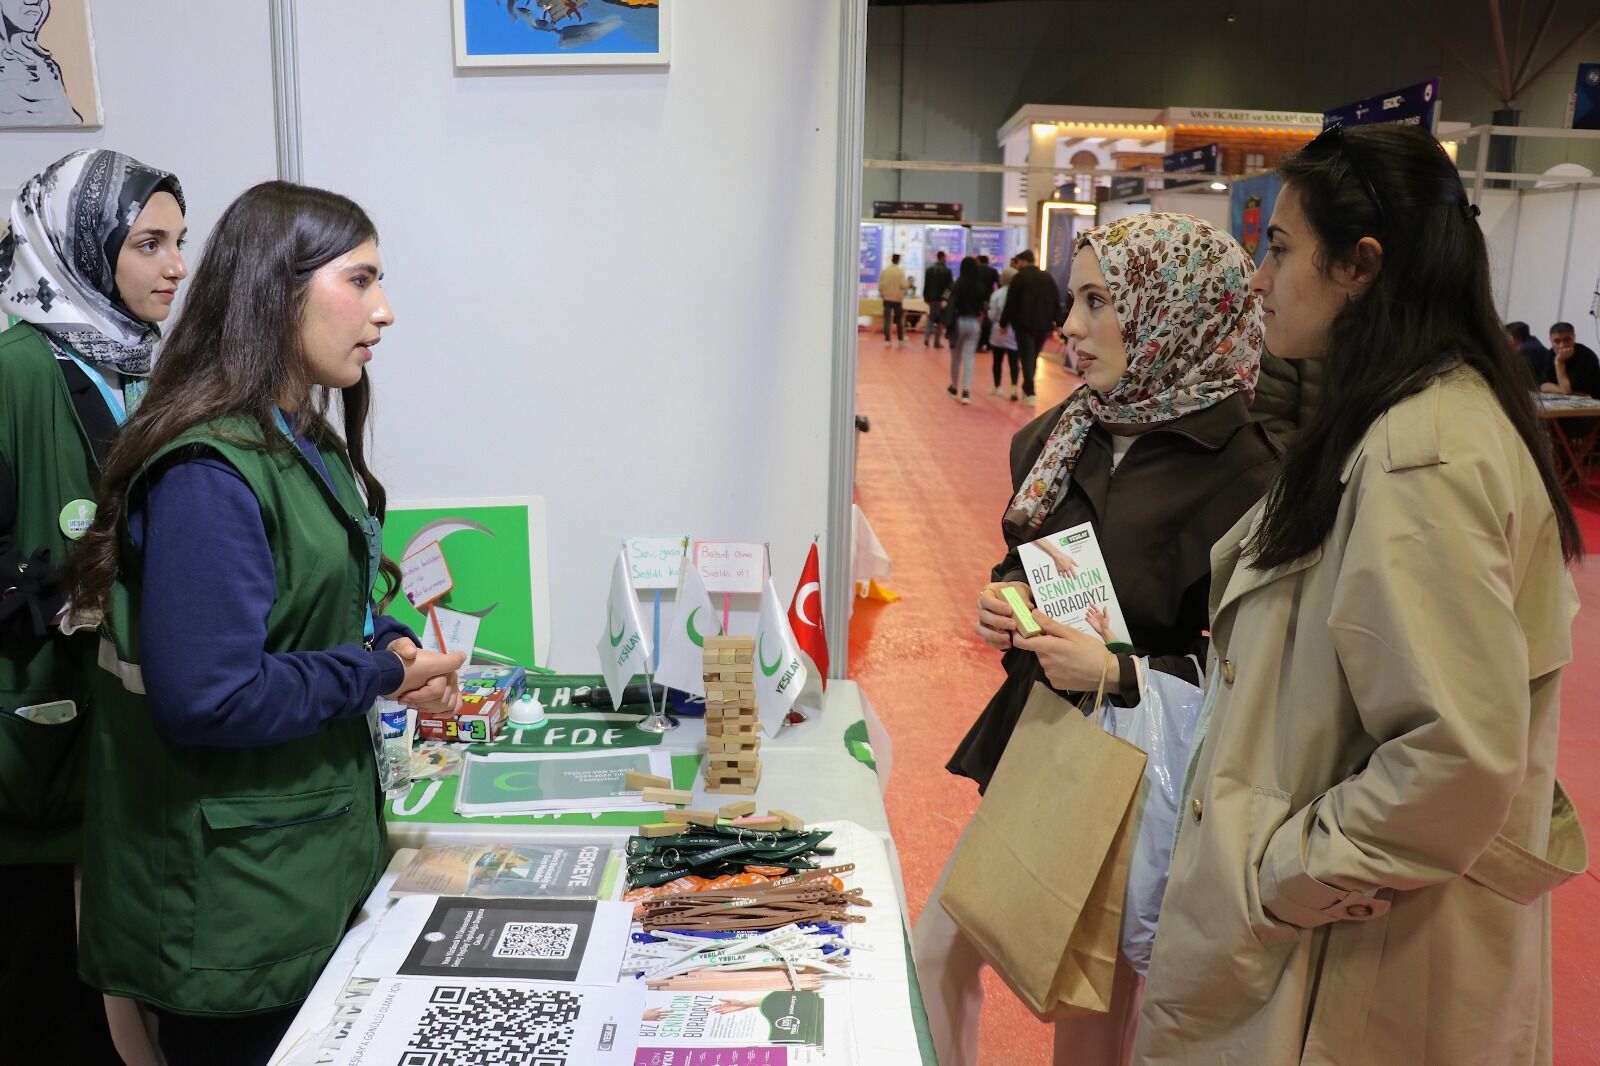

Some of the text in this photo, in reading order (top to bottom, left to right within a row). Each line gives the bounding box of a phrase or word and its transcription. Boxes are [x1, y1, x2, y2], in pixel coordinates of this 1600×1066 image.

[1190, 110, 1209, 119] VAN
[1032, 564, 1053, 584] BİZ
[1044, 585, 1109, 619] BURADAYIZ
[617, 631, 642, 667] YEŞİLAY
[775, 658, 801, 694] YEŞİLAY
[699, 949, 727, 960] YEŞİLAY
[718, 954, 747, 963] YEŞİLAY
[683, 995, 714, 1038] BURADAYIZ
